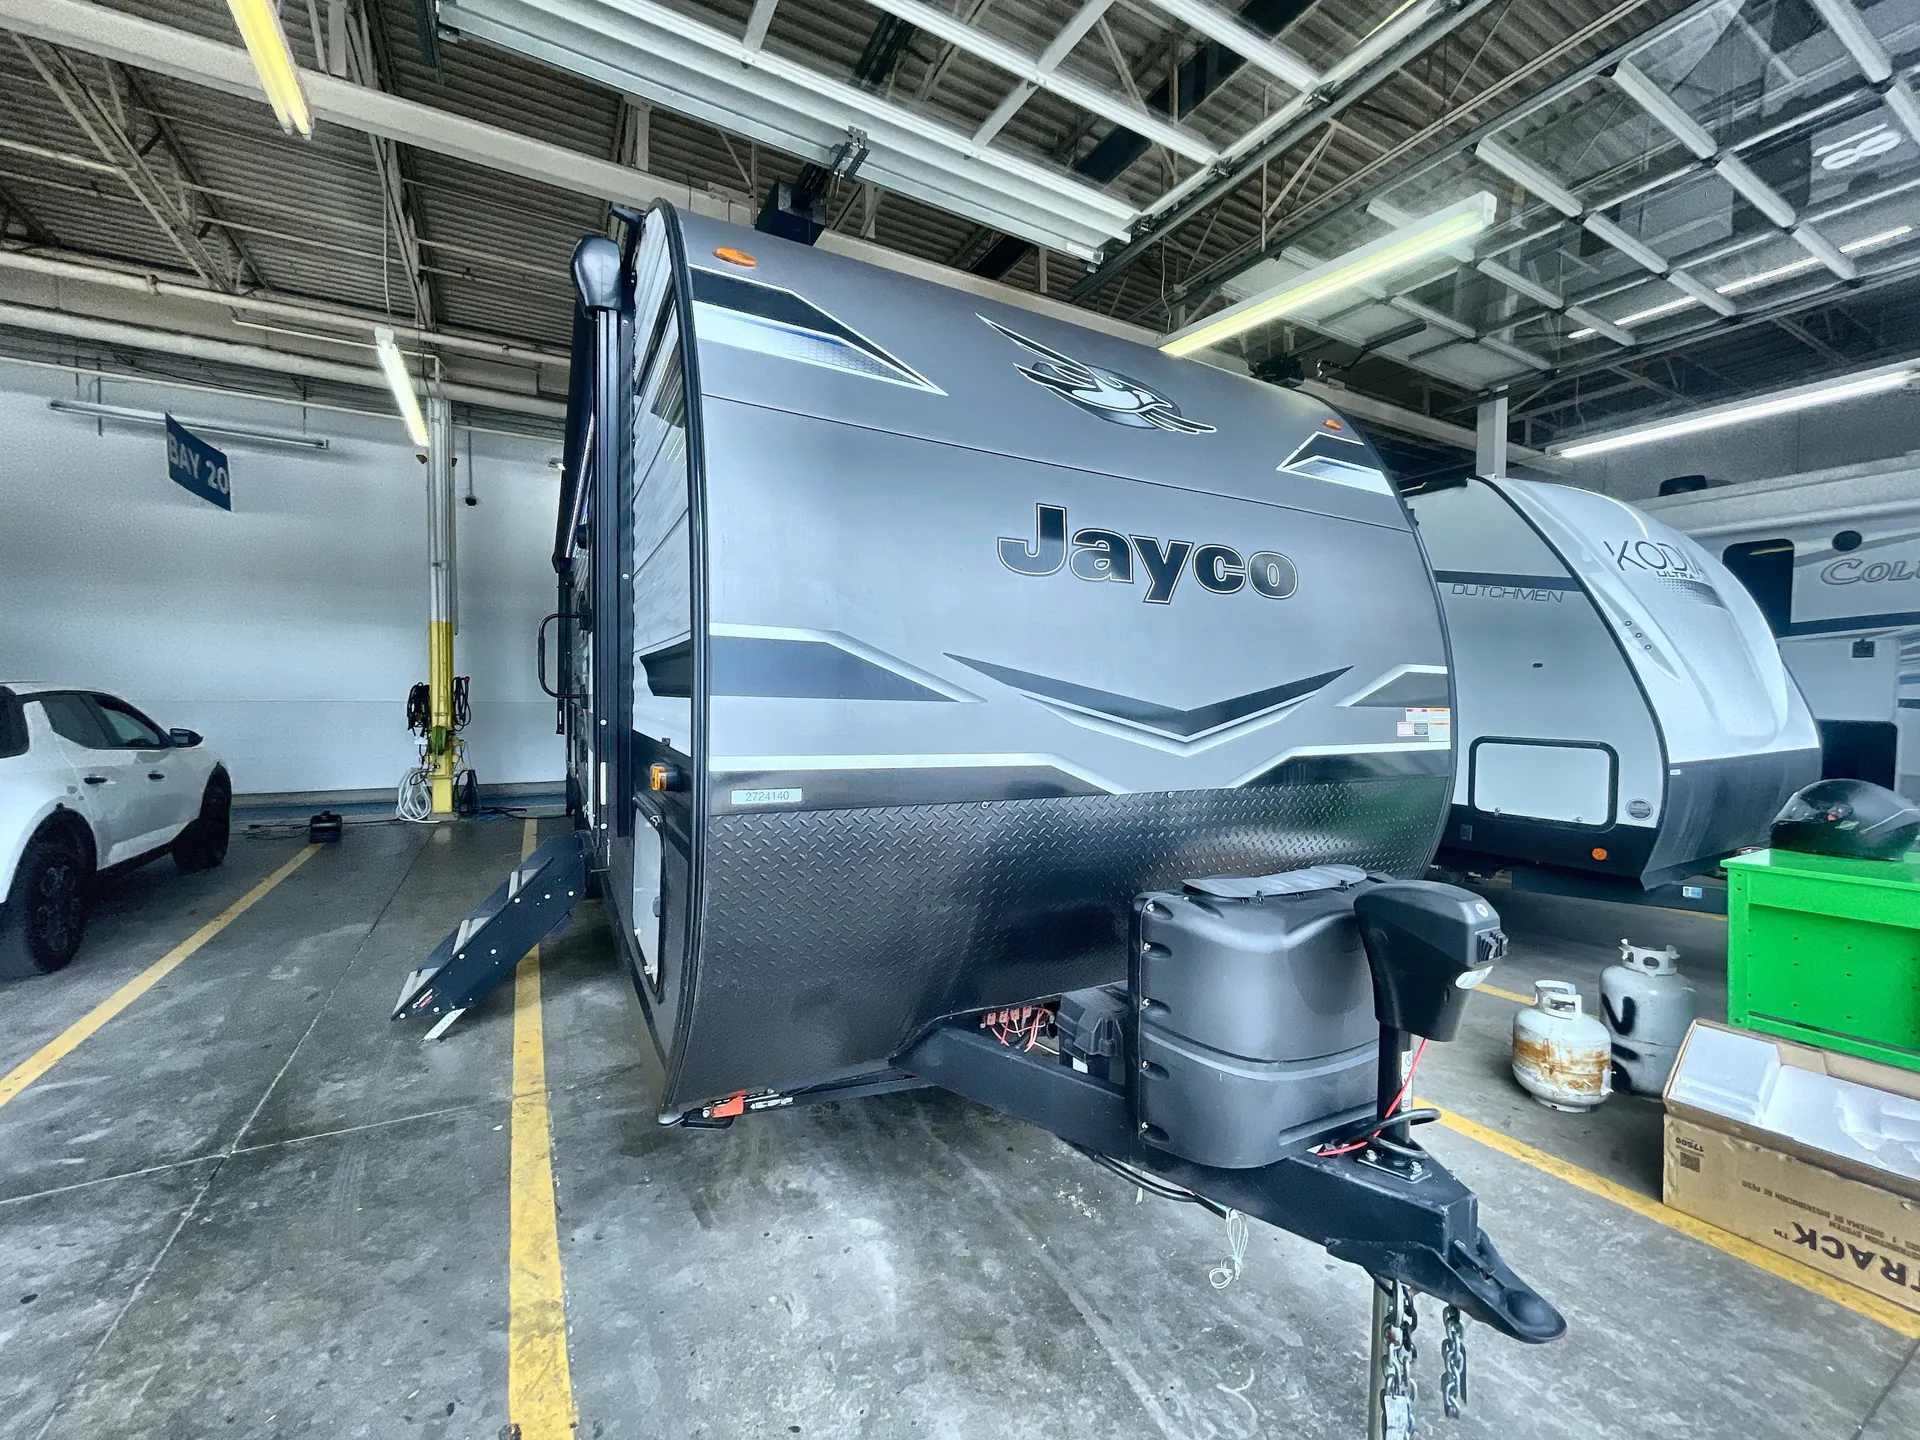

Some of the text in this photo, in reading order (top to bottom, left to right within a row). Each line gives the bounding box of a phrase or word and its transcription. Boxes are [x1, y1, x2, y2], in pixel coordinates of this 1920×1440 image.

[167, 431, 229, 495] BAY 20
[997, 502, 1299, 605] Jayco
[1656, 570, 1697, 580] ULTRA
[1451, 583, 1565, 604] DUTCHMEN
[745, 790, 790, 802] 2724140
